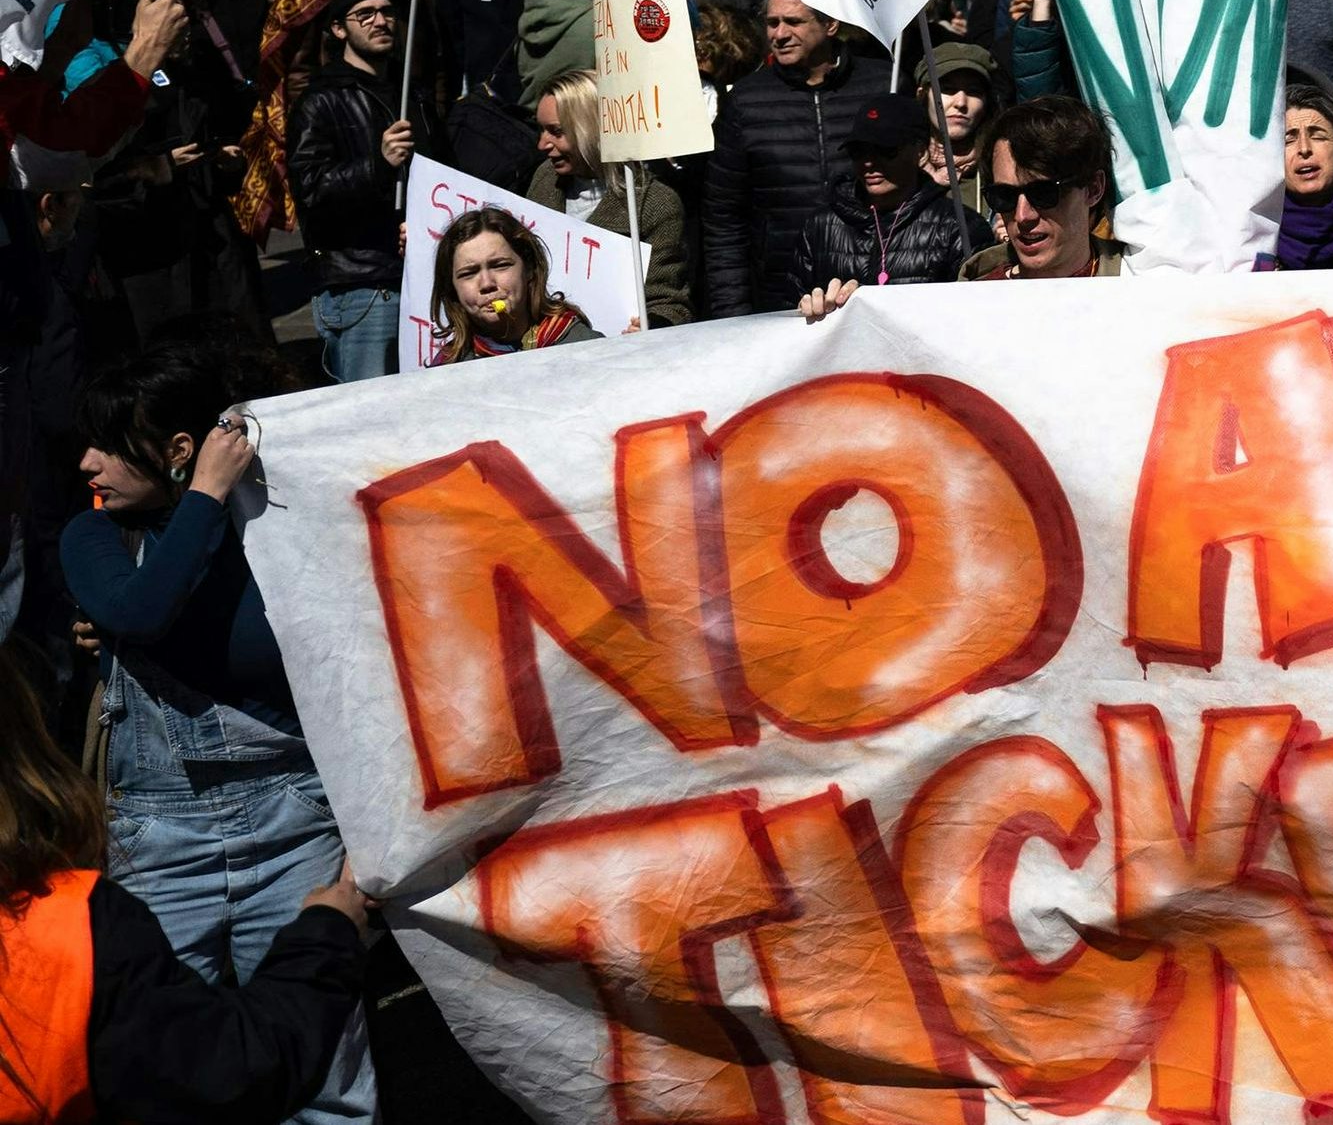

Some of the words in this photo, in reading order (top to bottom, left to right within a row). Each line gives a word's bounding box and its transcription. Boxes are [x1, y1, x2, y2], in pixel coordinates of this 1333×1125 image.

[616, 49, 629, 74] IN
[565, 230, 601, 280] IT
[355, 372, 1085, 811] NO
